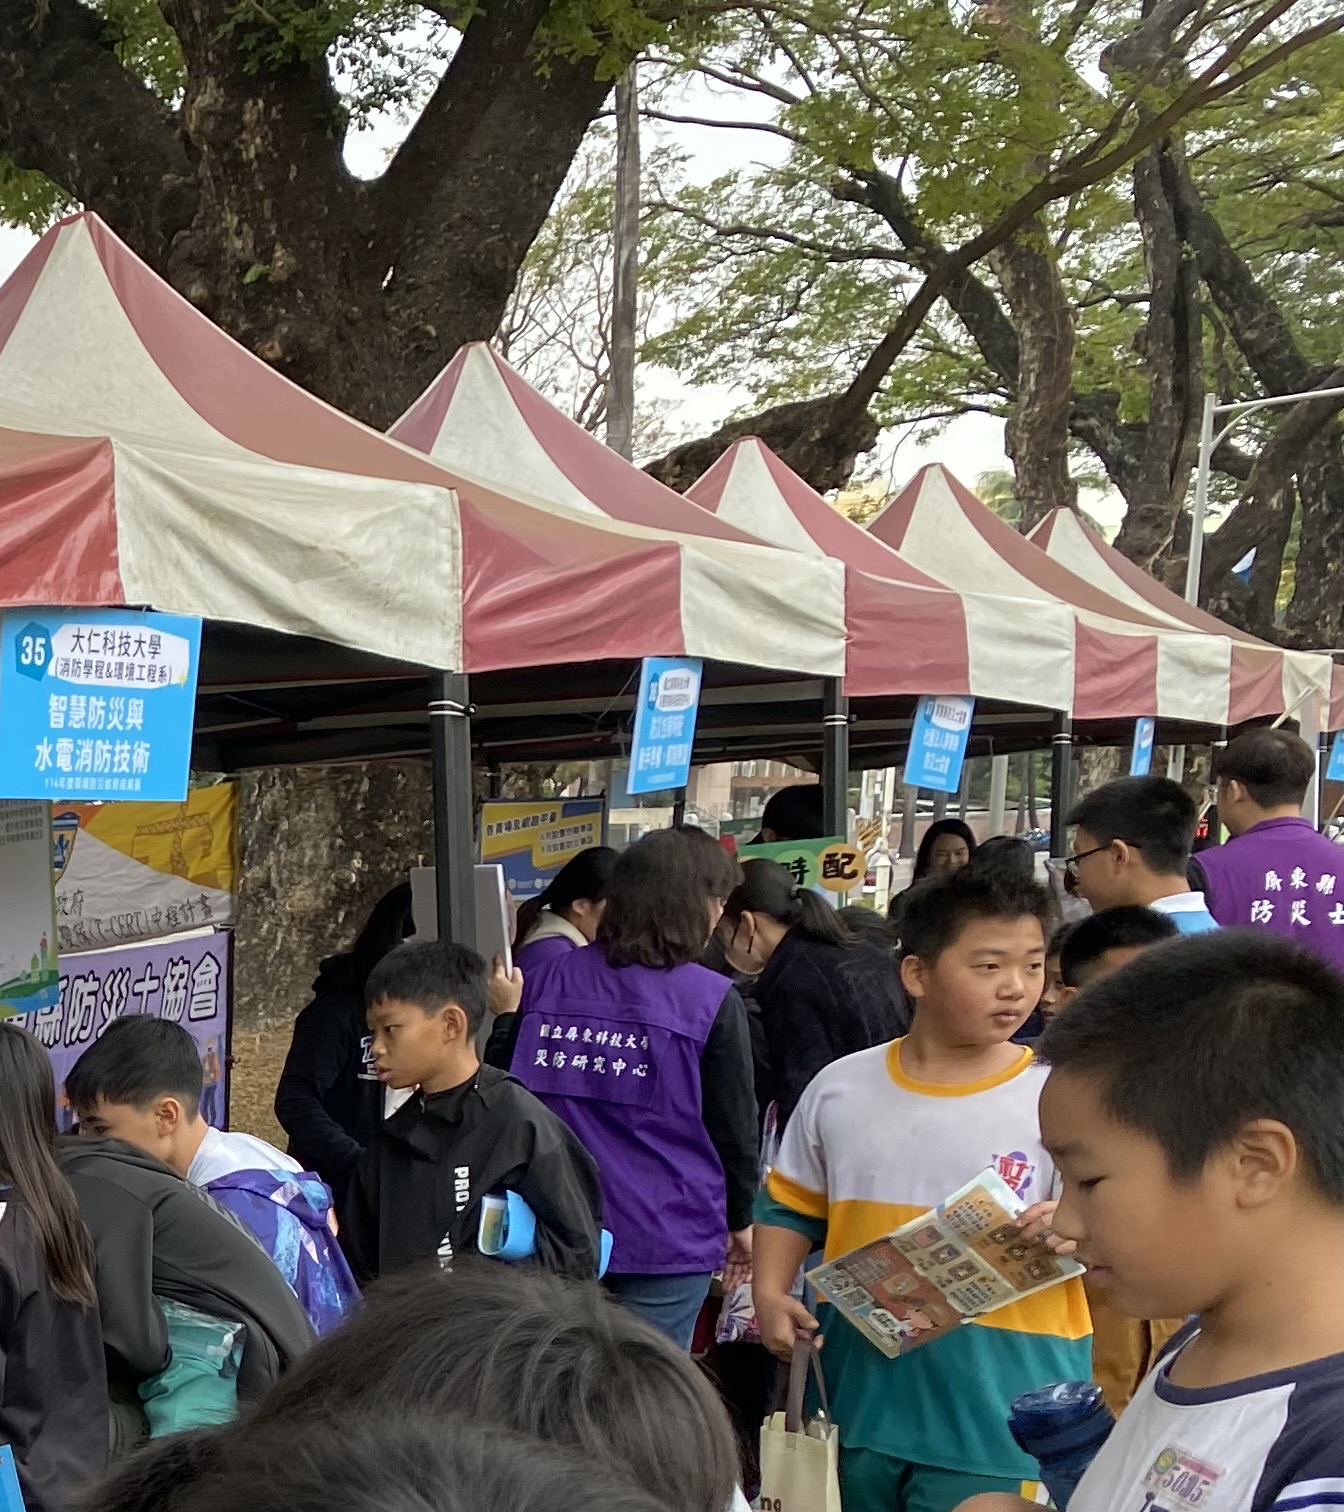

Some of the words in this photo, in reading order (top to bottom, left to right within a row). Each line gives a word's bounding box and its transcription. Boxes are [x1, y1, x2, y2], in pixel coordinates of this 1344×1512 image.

[20, 635, 47, 667] 35
[70, 626, 162, 660] 大仁科技大學
[48, 692, 145, 732] 智慧防災與
[34, 736, 151, 774] 水電消防技術
[533, 1048, 649, 1078] 災防研究中心
